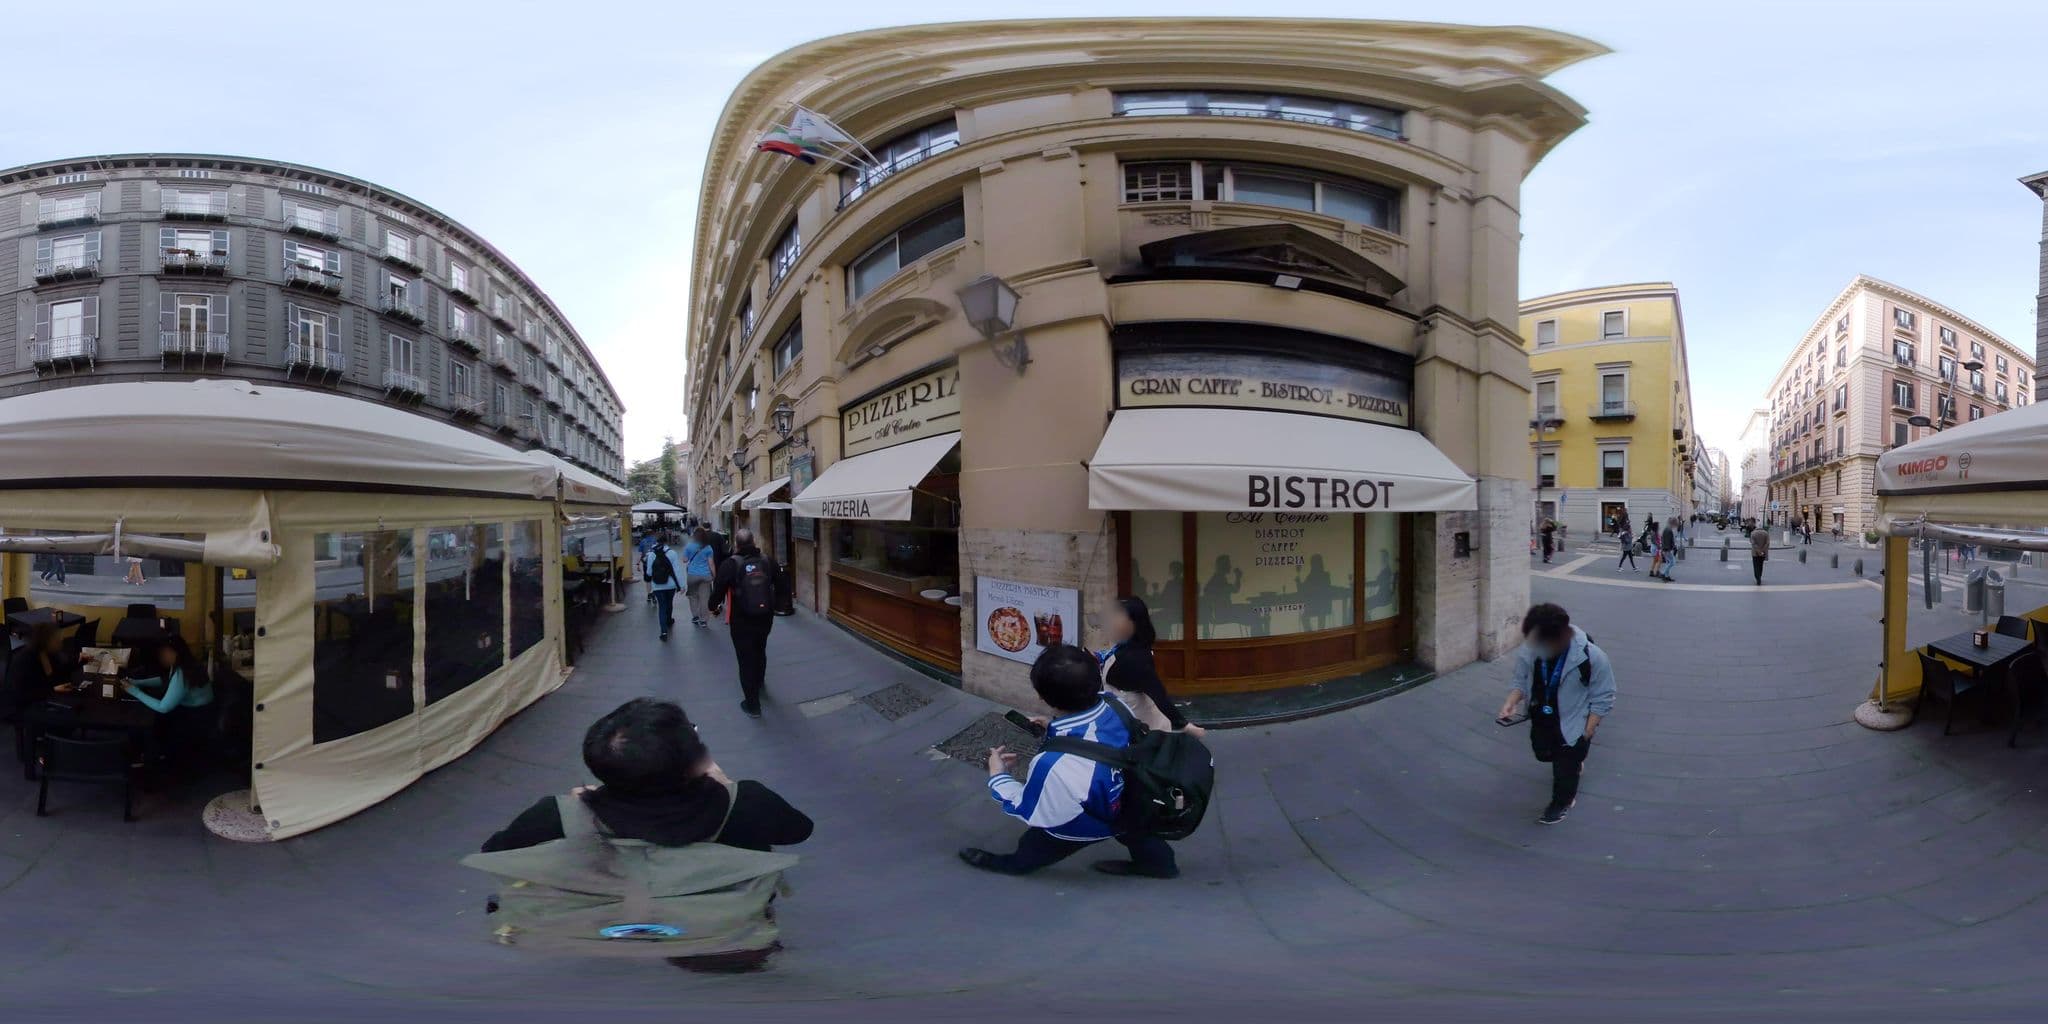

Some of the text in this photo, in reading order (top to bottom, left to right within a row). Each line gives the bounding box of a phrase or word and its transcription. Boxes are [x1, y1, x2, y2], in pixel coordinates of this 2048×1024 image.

[1131, 378, 1181, 395] GRAN
[1261, 382, 1333, 404] BISTROT
[1348, 392, 1402, 416] PIZZERIA
[1898, 455, 1948, 476] KIMBO
[1248, 474, 1394, 508] BISTROT
[822, 499, 871, 517] PIZZERIA
[1255, 528, 1305, 539] BISTROT
[1255, 556, 1305, 566] PIZZERIA
